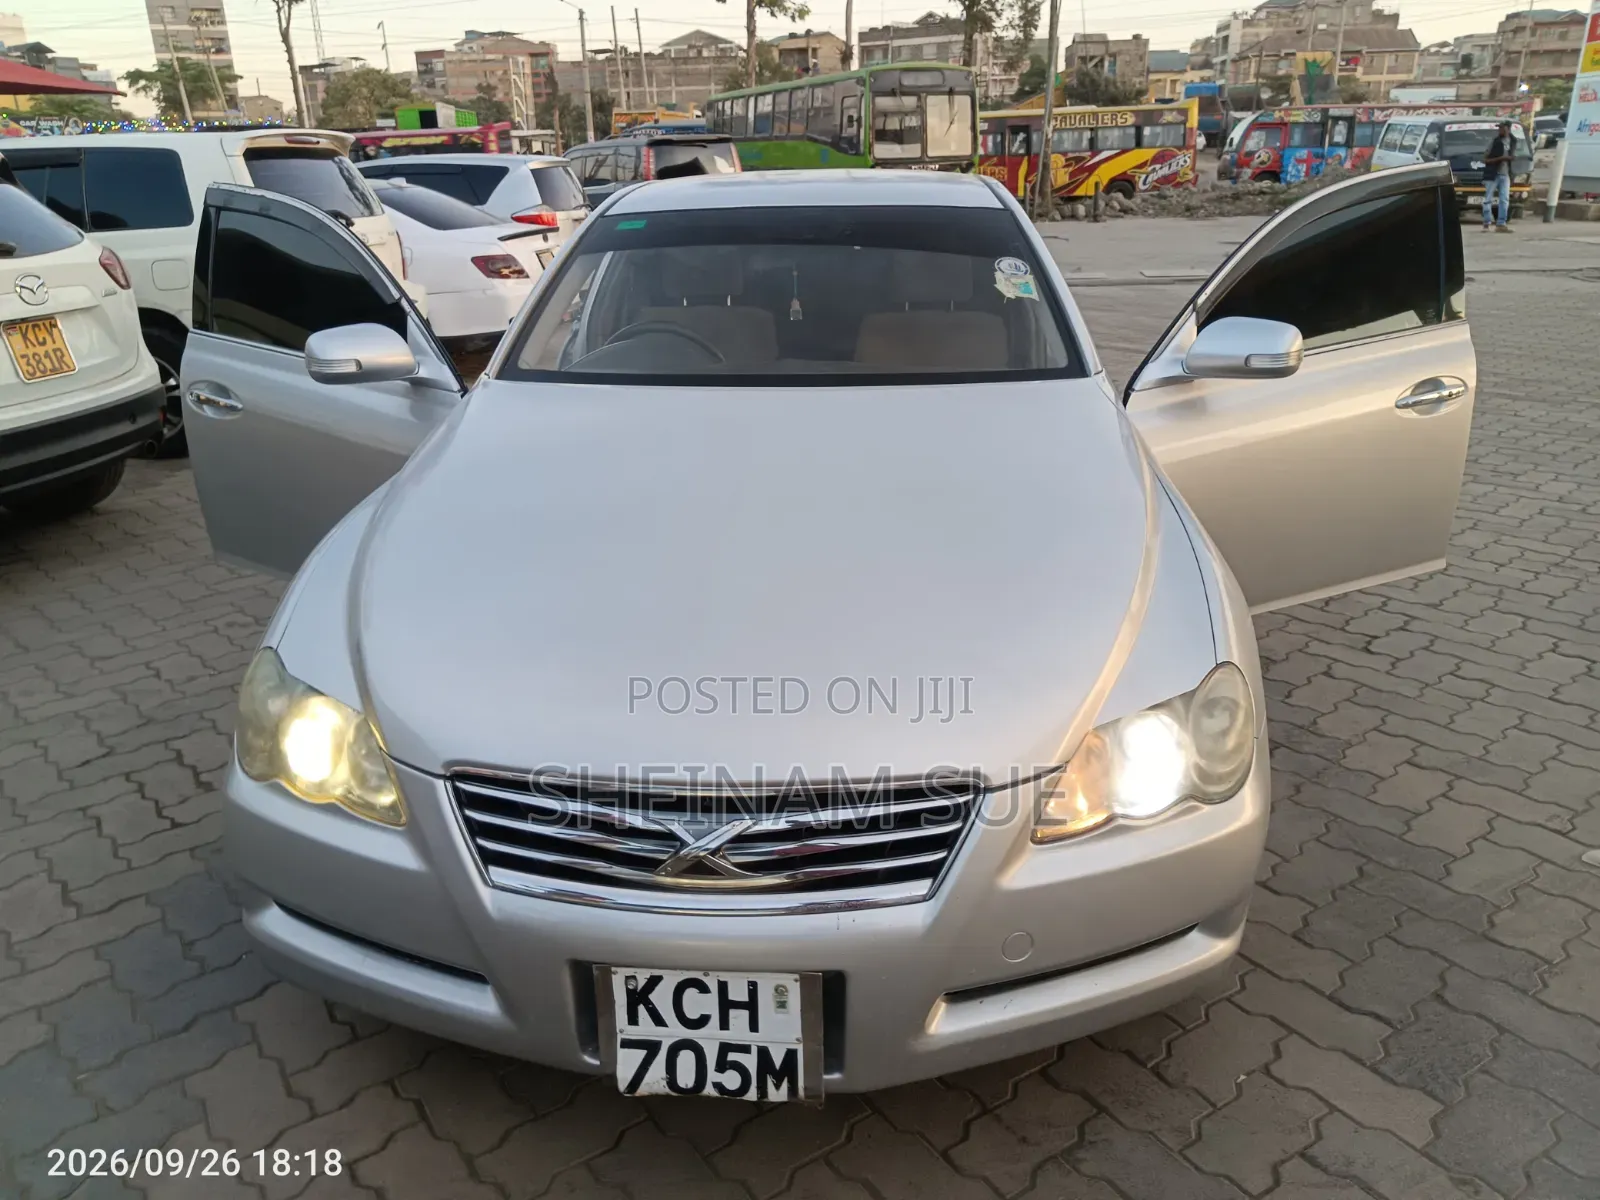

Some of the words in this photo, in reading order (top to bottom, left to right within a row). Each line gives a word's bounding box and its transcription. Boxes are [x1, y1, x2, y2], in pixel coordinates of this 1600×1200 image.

[38, 119, 64, 127] WASH
[19, 320, 57, 349] KCY
[20, 347, 71, 377] 381R
[624, 974, 760, 1034] KCH
[620, 1037, 799, 1102] 705M
